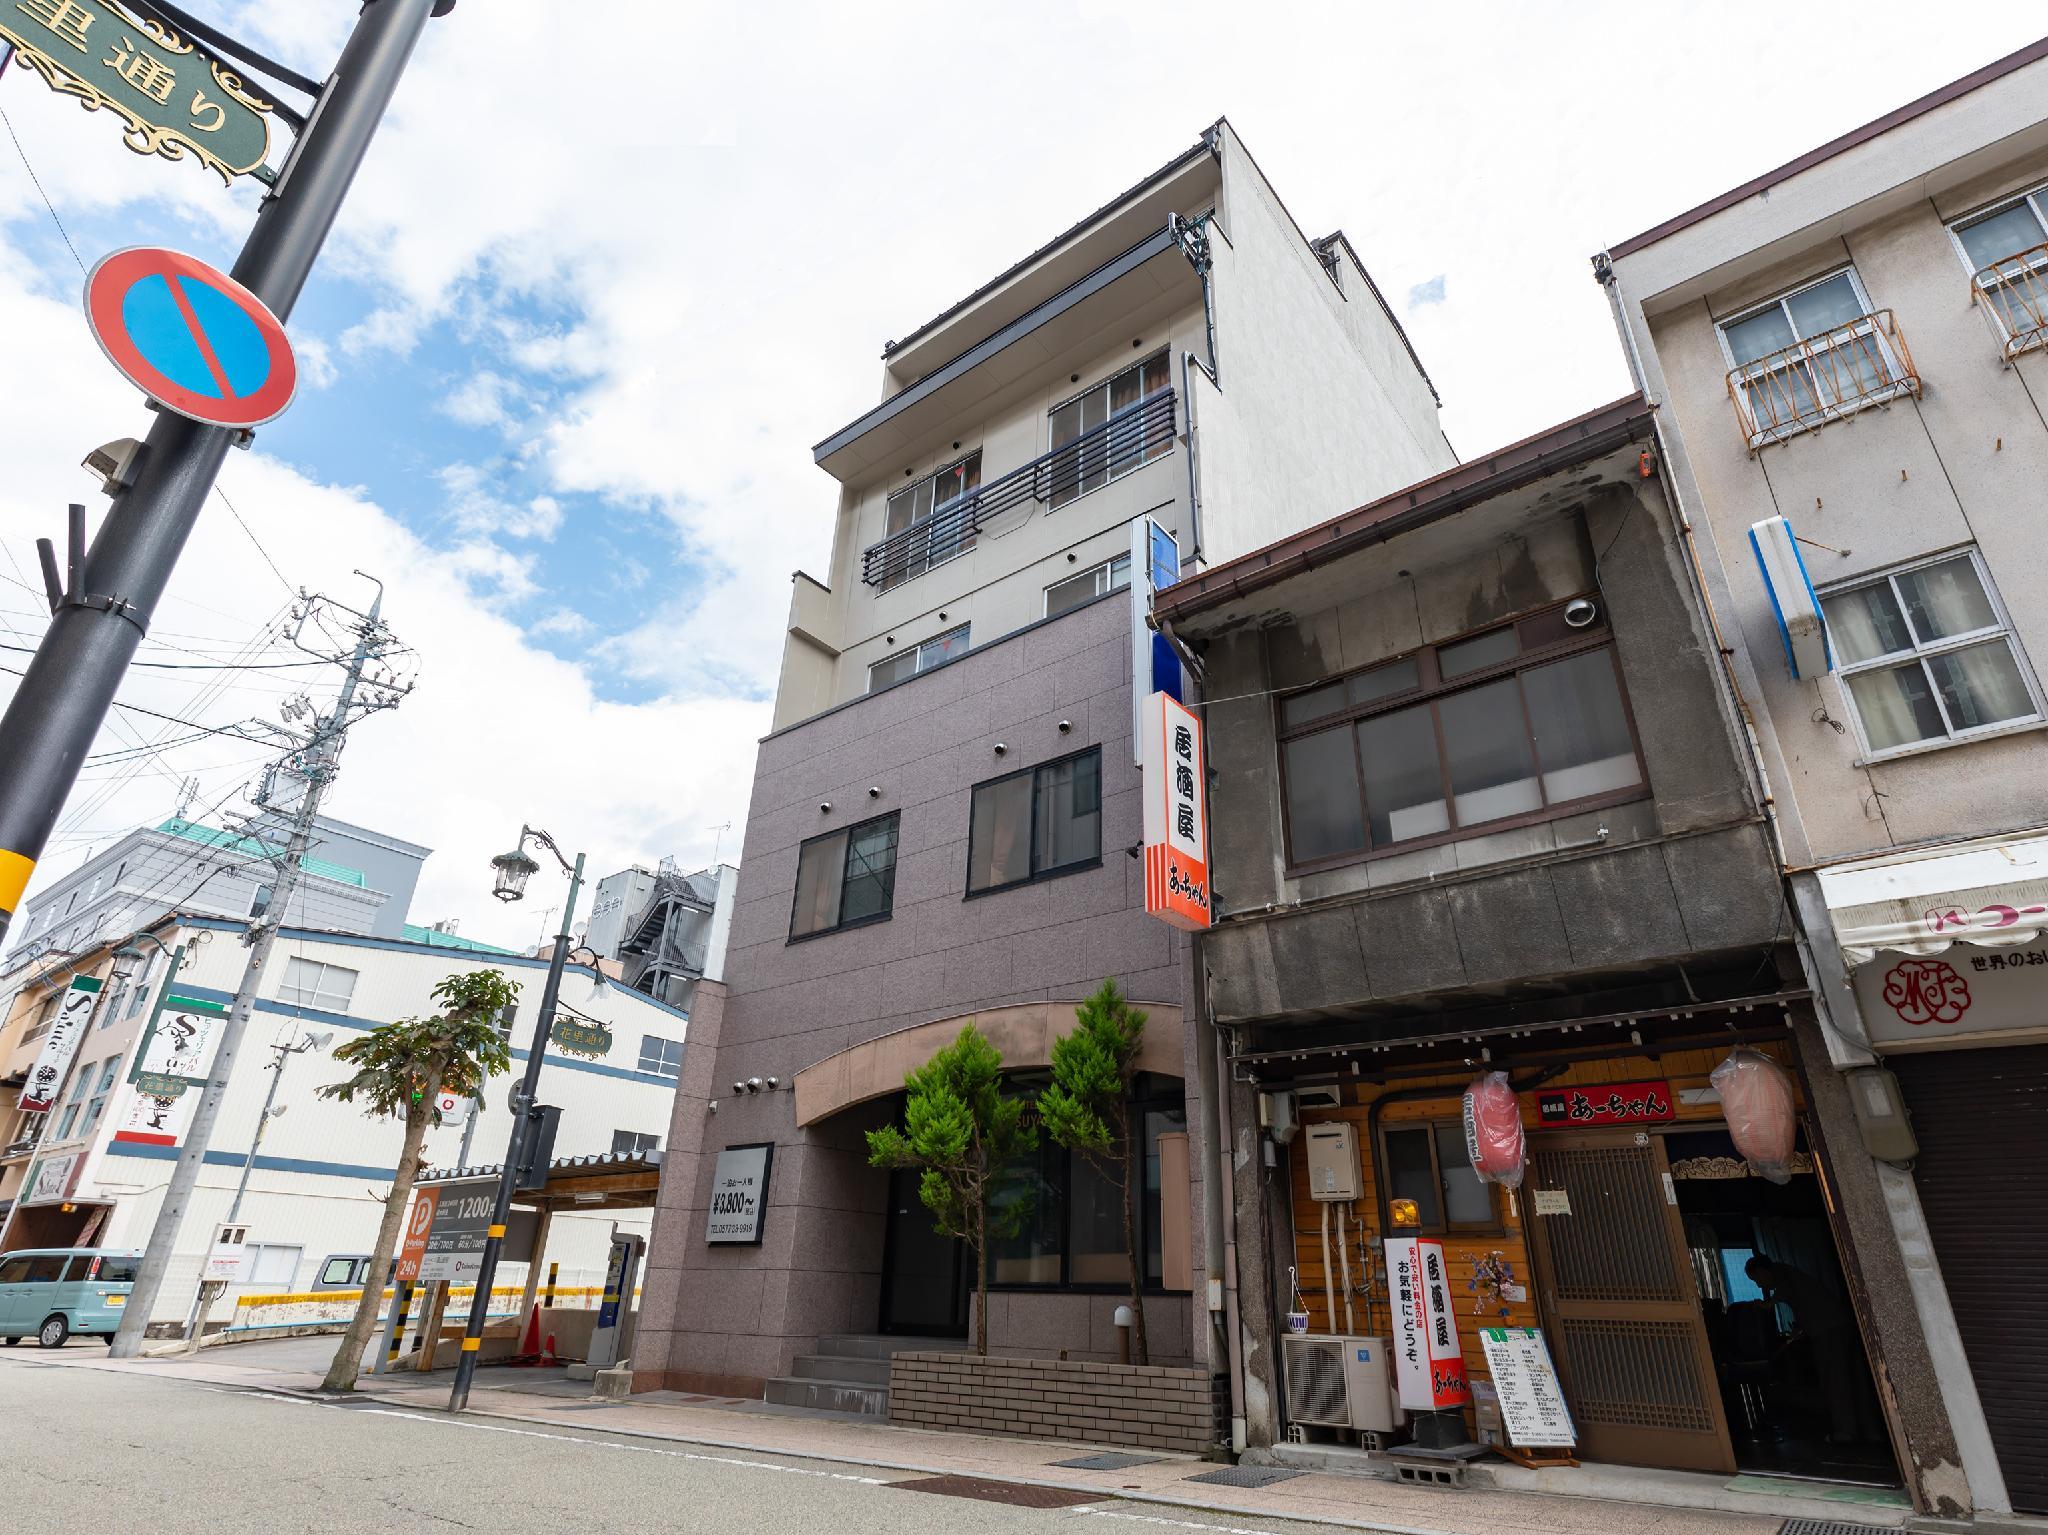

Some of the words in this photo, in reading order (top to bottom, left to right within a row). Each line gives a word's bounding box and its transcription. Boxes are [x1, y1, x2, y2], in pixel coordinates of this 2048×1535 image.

[1174, 725, 1196, 843] 居酒屋
[1168, 857, 1208, 909] あーちゃん
[1569, 1091, 1668, 1121] あーちゃん
[1427, 1252, 1450, 1347] 居酒屋
